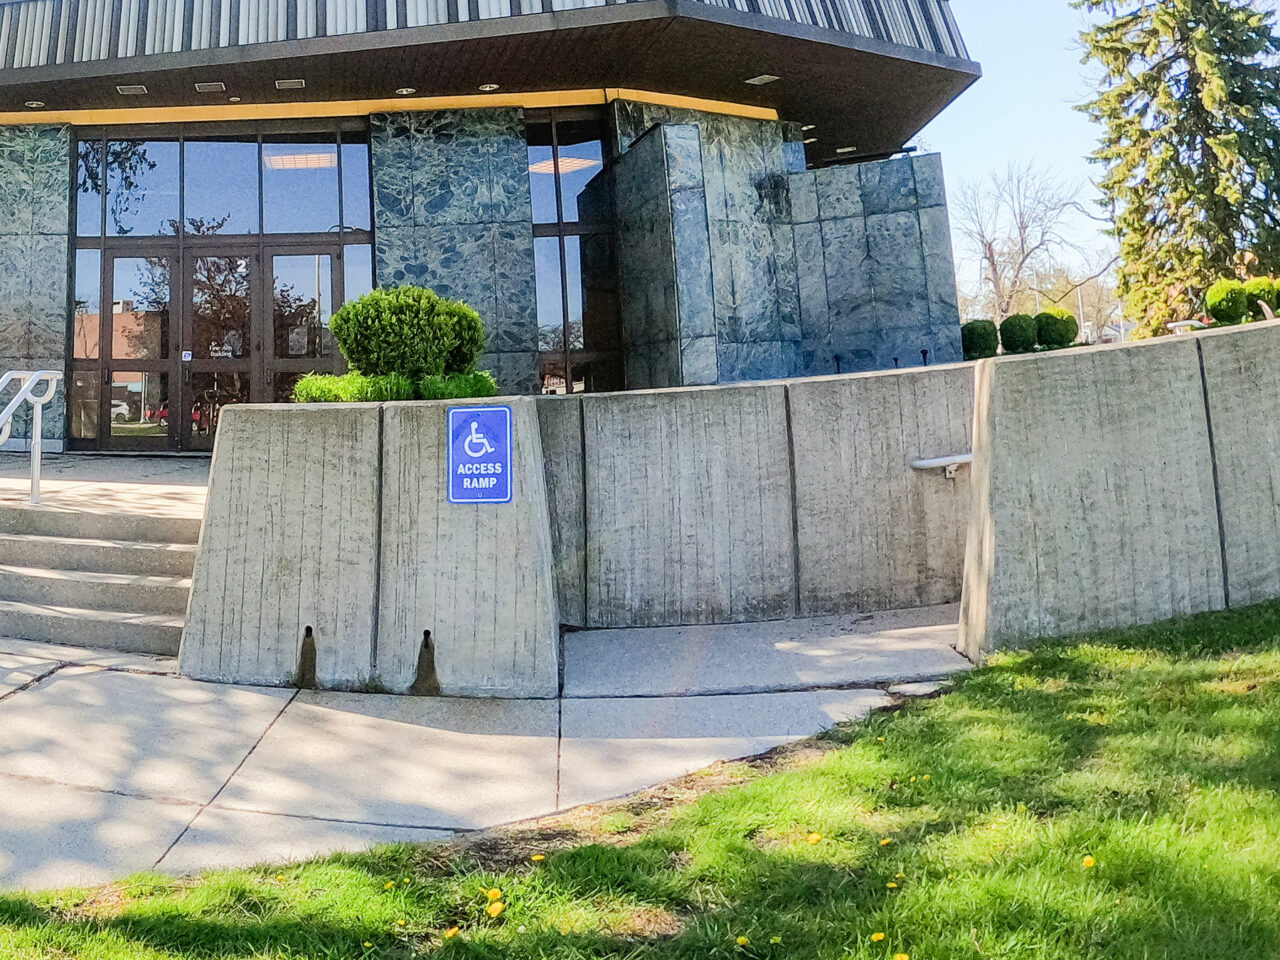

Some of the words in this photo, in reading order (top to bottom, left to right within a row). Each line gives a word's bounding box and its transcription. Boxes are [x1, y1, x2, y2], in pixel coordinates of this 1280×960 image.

[236, 259, 247, 273] 2
[457, 462, 503, 475] ACCESS
[463, 477, 498, 489] RAMP
